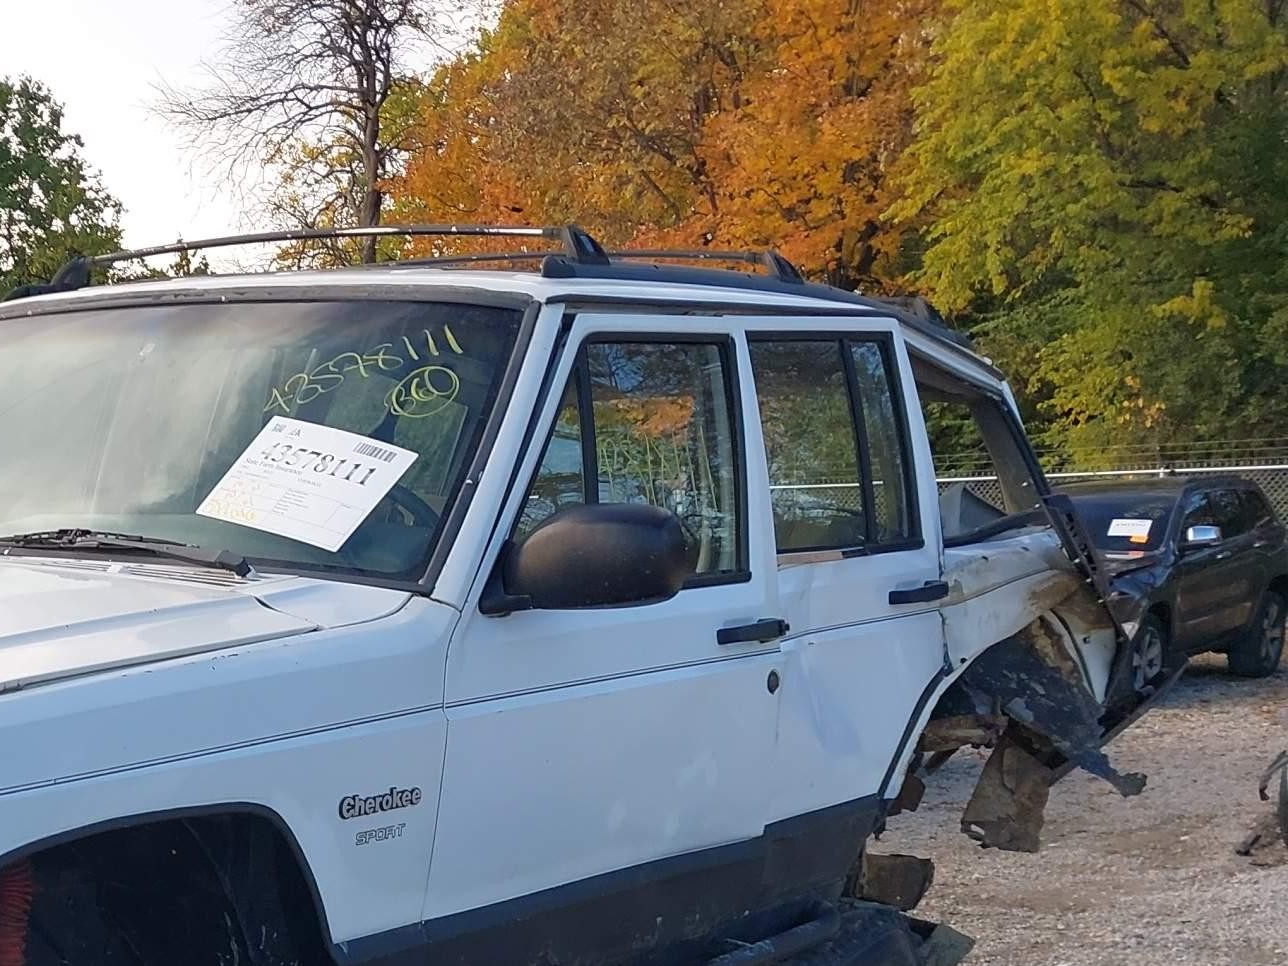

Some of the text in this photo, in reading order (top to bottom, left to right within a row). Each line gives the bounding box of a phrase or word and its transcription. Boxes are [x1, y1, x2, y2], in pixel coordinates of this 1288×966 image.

[261, 442, 377, 486] 43578111
[338, 786, 422, 820] Cherokee
[355, 823, 406, 846] SPORT
